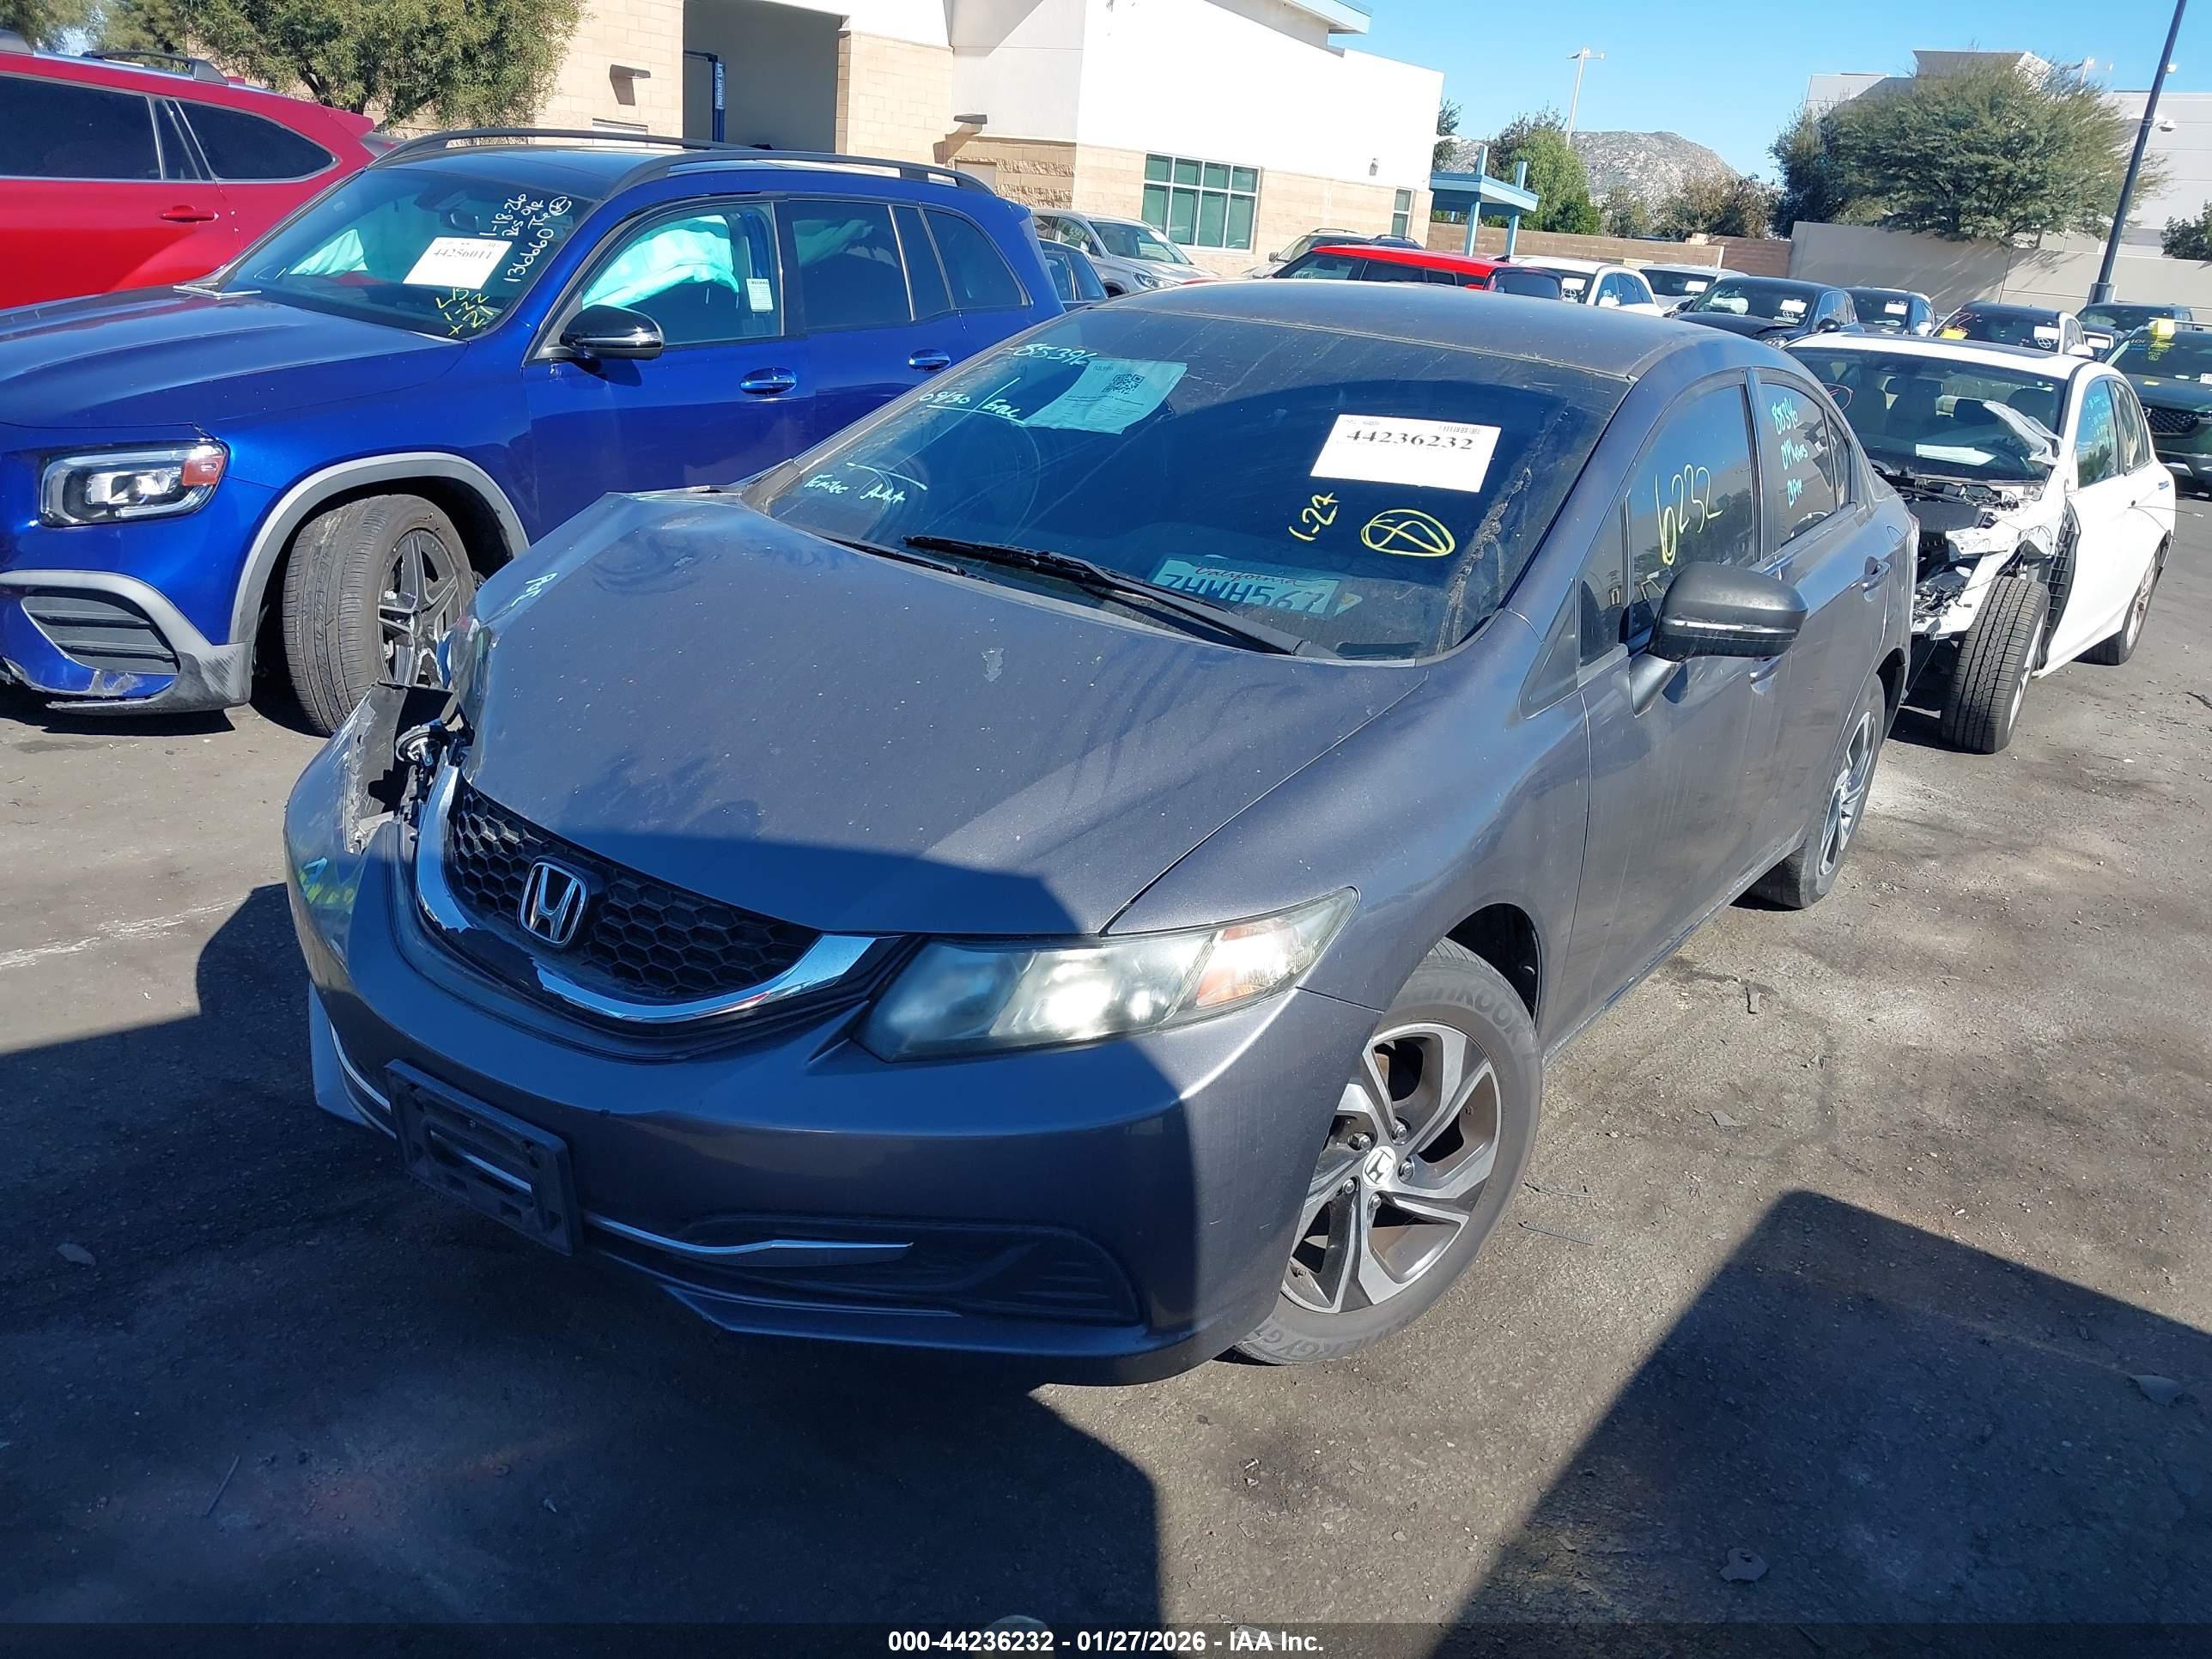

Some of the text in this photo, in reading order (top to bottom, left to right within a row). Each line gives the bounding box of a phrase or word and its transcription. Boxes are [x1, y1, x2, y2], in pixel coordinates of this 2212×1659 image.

[1346, 429, 1474, 451] 44236232
[1654, 463, 1723, 566] 6232
[1194, 565, 1307, 587] California
